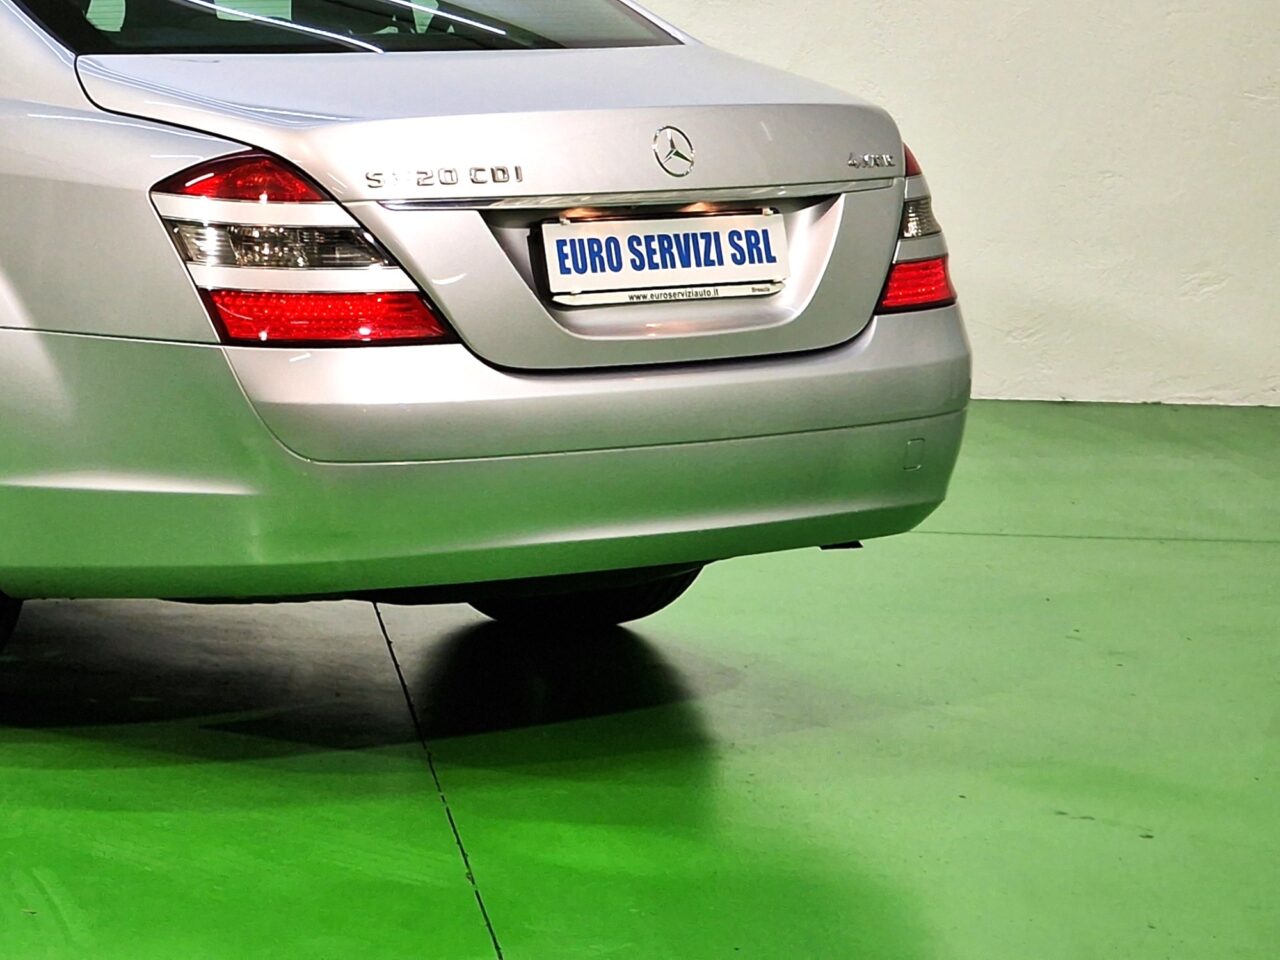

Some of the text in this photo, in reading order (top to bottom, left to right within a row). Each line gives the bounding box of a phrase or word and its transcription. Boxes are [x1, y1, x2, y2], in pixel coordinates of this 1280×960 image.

[365, 164, 524, 189] S20 CDI
[555, 228, 778, 276] EURO SERVIZI SRL
[628, 287, 720, 302] www.euroserviziauto.it
